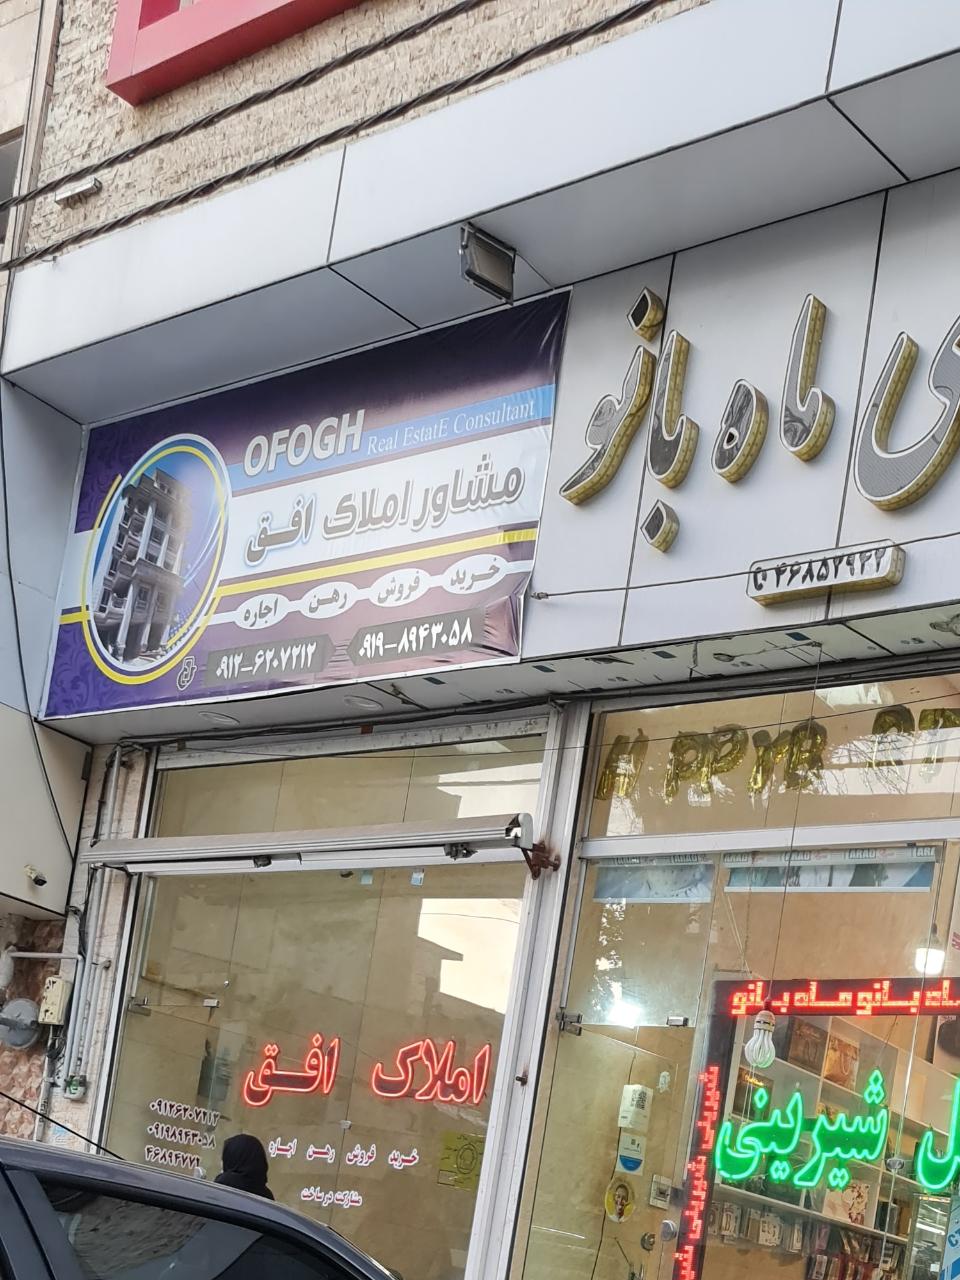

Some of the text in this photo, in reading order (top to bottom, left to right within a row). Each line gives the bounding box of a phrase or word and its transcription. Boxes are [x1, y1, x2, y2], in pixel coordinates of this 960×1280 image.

[711, 294, 836, 484] ماه
[243, 408, 366, 478] OFOGH
[367, 400, 536, 456] Real EstatE Consultant
[559, 287, 701, 553] بانو
[244, 451, 526, 568] مشاور املاک افق
[376, 569, 421, 605] فروش
[449, 556, 503, 592] خرید
[242, 597, 279, 628] اجاره
[307, 586, 349, 615] رهن
[794, 981, 852, 1007] ماه
[856, 980, 921, 1016] بانو
[244, 1033, 491, 1106] املاک افق
[716, 1067, 888, 1187] شیرینی
[269, 1137, 420, 1169] خرید فروش رهن اجاره
